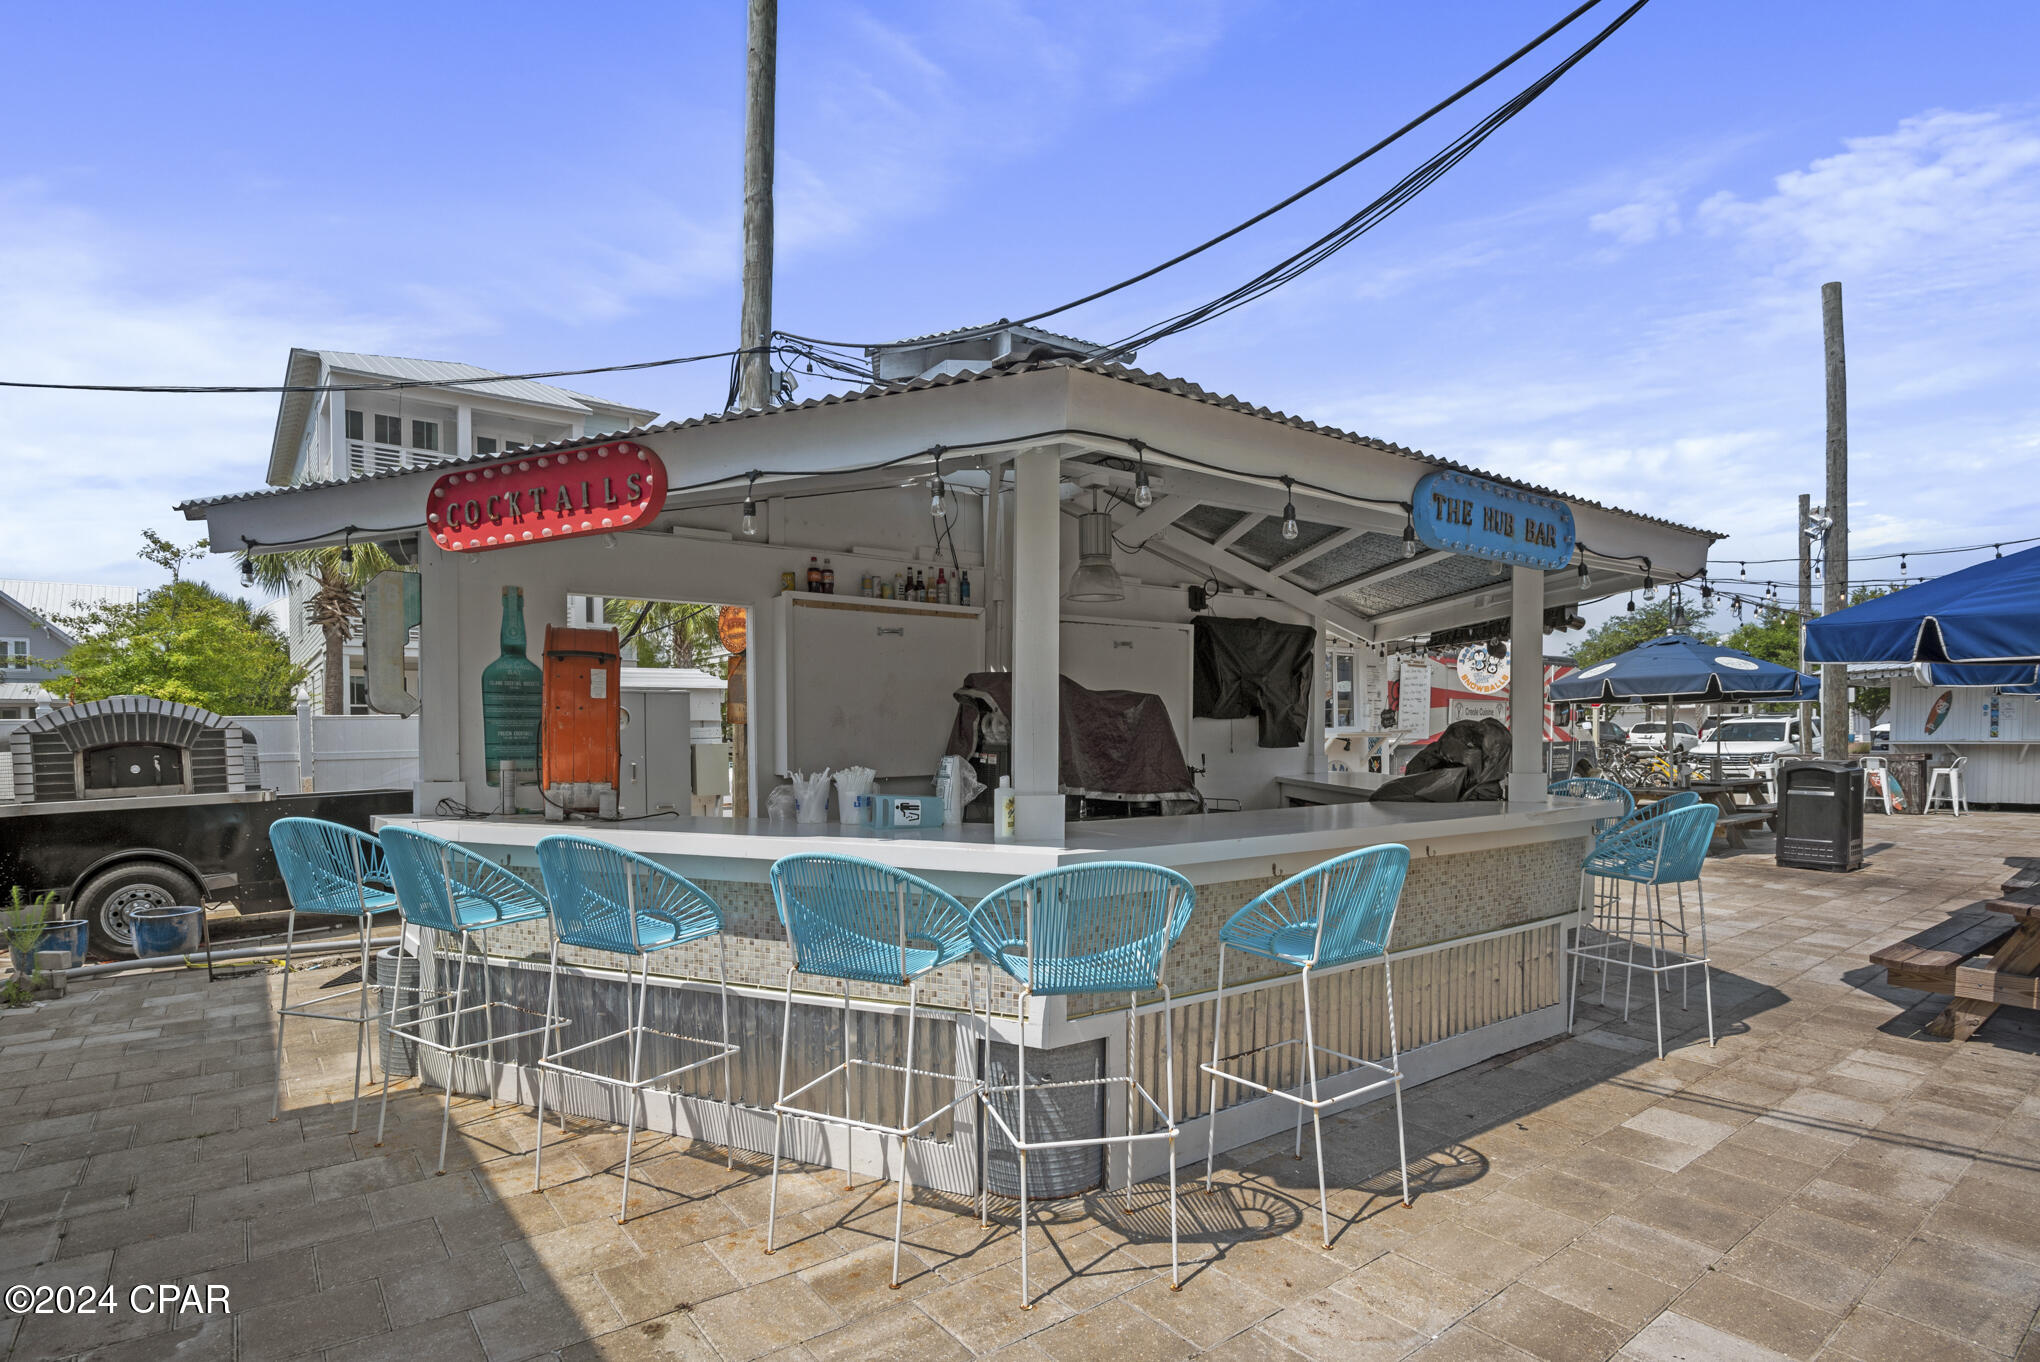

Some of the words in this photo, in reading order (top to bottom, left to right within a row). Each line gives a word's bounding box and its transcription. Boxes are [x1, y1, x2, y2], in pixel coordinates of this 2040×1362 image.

[446, 473, 642, 528] COCKTAILS
[1433, 493, 1474, 526] THE
[1483, 505, 1514, 538] HUB
[1525, 517, 1557, 548] BAR
[1461, 674, 1509, 692] SNOWBALLS
